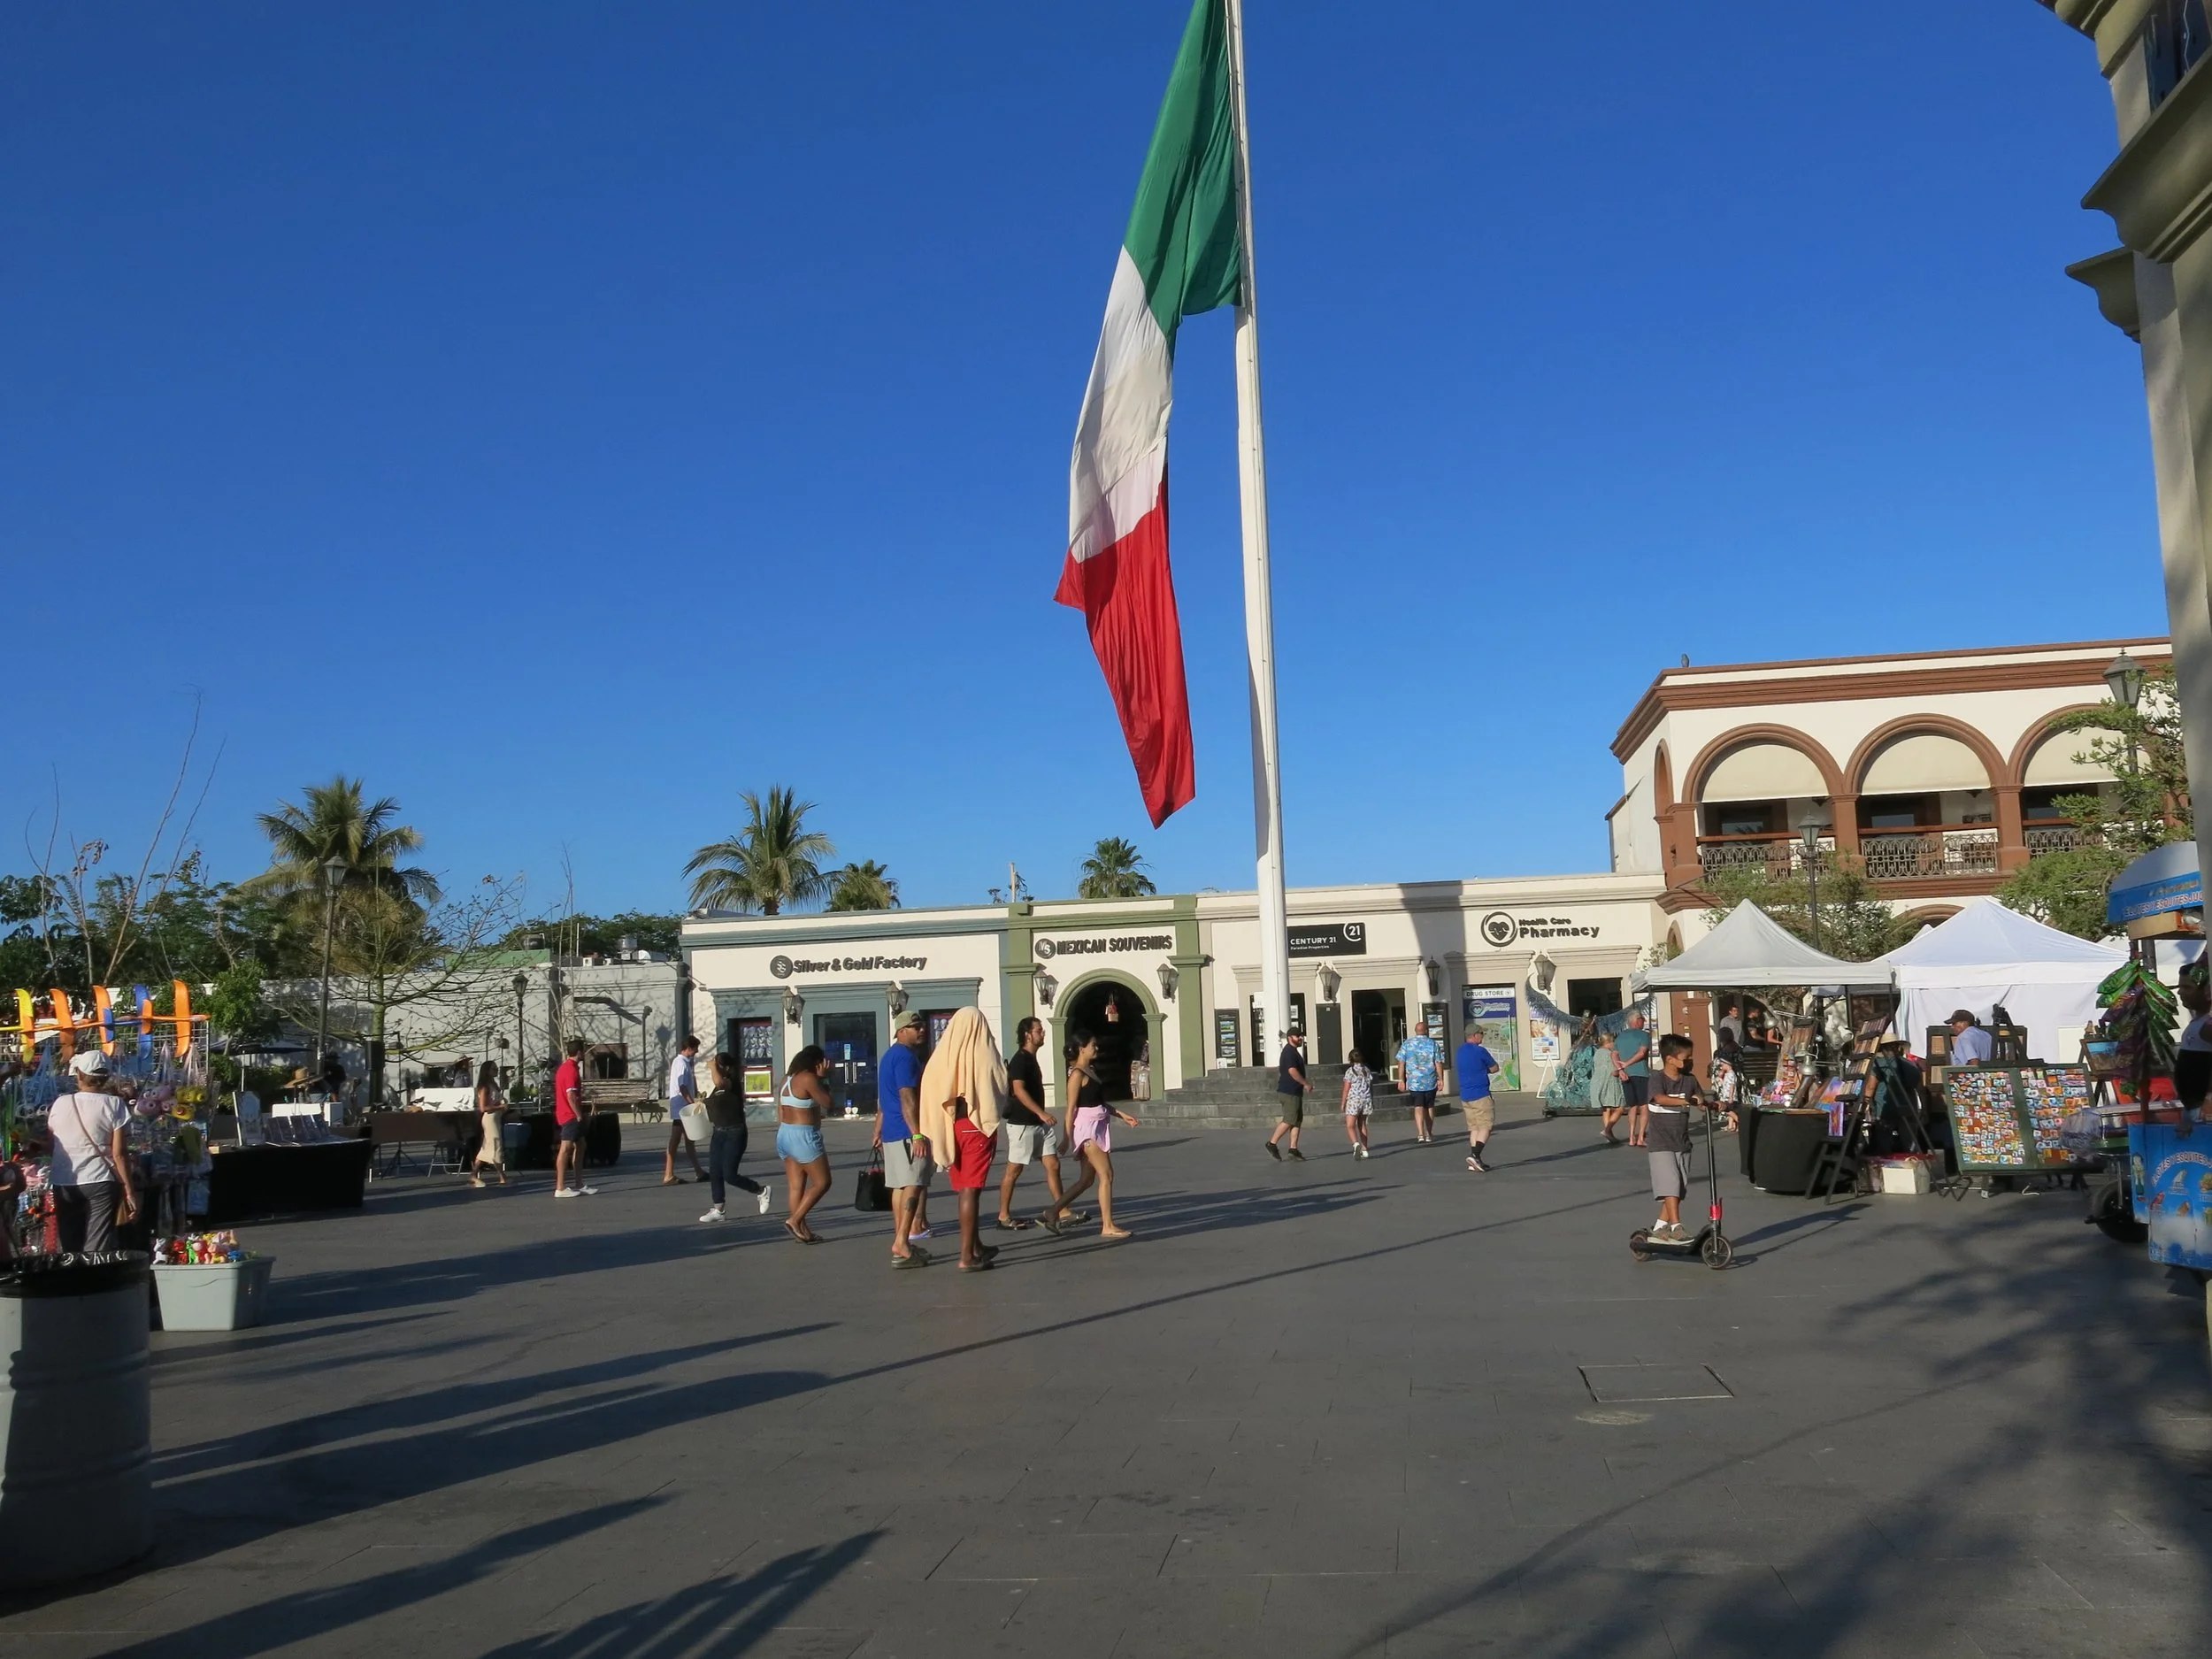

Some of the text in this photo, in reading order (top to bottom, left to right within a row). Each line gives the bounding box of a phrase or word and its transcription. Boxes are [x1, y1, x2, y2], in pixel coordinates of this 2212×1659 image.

[1519, 926, 1600, 939] Pharmacy
[1056, 935, 1172, 955] MEXICAN SOUVENIRS
[793, 959, 831, 973] Silver
[831, 958, 841, 971] &
[842, 956, 874, 971] Gold
[874, 956, 927, 971] Factory
